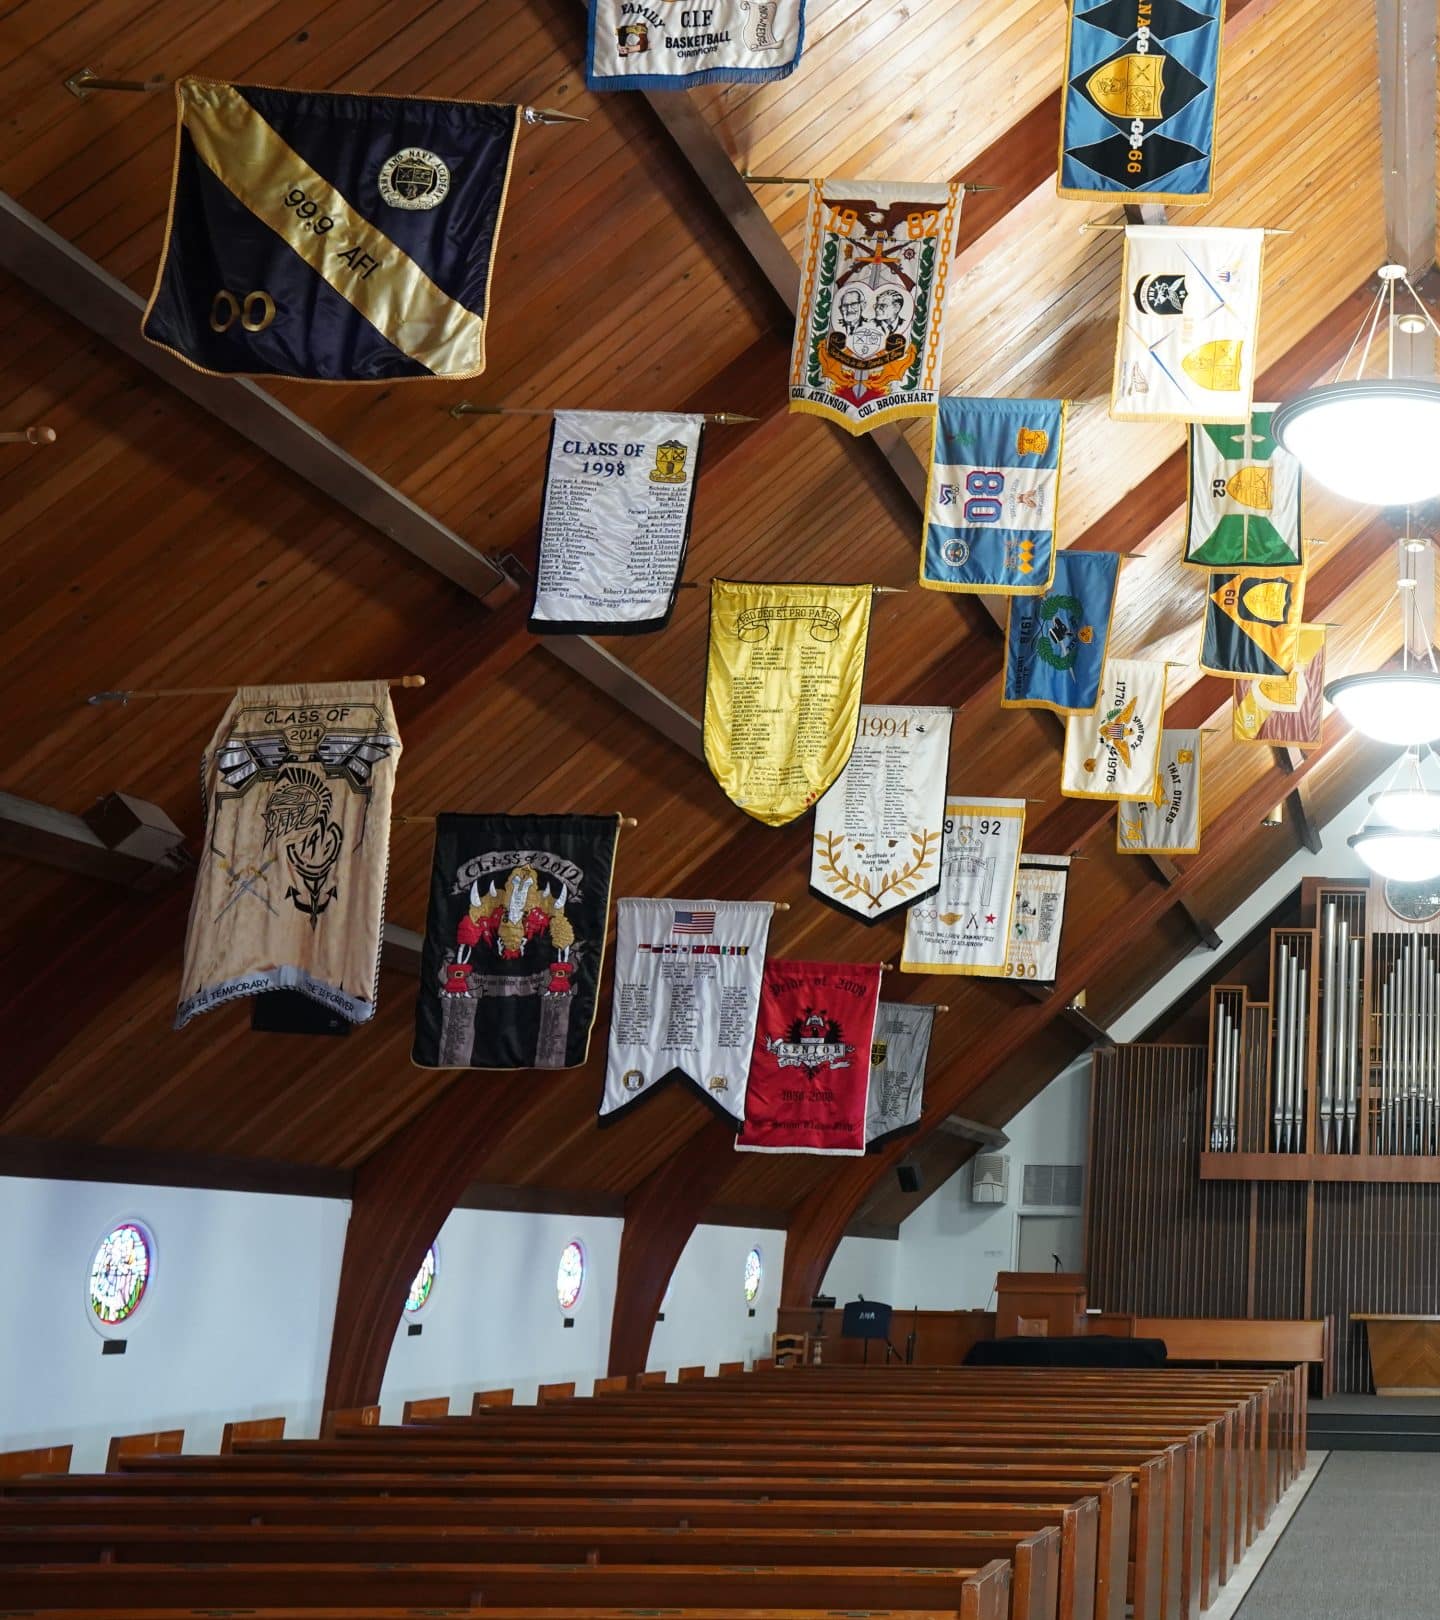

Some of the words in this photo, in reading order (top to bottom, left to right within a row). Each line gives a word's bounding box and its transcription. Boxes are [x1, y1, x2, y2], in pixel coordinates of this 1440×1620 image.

[622, 3, 666, 29] FAMILY
[665, 31, 731, 48] BASKETBALL
[1128, 150, 1142, 173] 66
[409, 151, 432, 159] NAVY
[434, 164, 446, 199] ACADEMY
[824, 205, 858, 236] 19
[907, 210, 940, 239] 82
[285, 189, 334, 235] 99.9
[338, 246, 378, 280] AFI
[210, 289, 276, 332] 00
[792, 388, 805, 398] COL
[808, 391, 849, 413] ATKINSON
[858, 402, 876, 418] COL
[878, 393, 934, 409] BROOKHART
[563, 440, 618, 456] CLASS
[624, 444, 645, 457] OF
[582, 461, 625, 477] 1998
[964, 471, 1005, 523] 80
[1213, 479, 1225, 498] 62
[1224, 589, 1235, 606] 60
[739, 612, 756, 622] PRO
[758, 609, 774, 618] DEO
[776, 609, 788, 618] ET
[789, 609, 806, 618] PRO
[809, 609, 840, 624] PATRIA
[1115, 681, 1125, 707] 1776
[264, 711, 320, 724] CLASS
[326, 709, 350, 722] OF
[861, 717, 909, 737] 1994
[1133, 716, 1144, 734] SPIRIT
[290, 729, 321, 741] 2014
[1107, 756, 1118, 783] 1976
[1166, 762, 1181, 784] THAT
[1165, 790, 1182, 824] OTHERS
[980, 820, 1001, 835] 92
[465, 853, 520, 878] CLASS
[540, 856, 580, 885] 2012
[210, 979, 269, 1000] TEMPORARY
[770, 978, 803, 997] Pride
[780, 1045, 844, 1054] SENIOR
